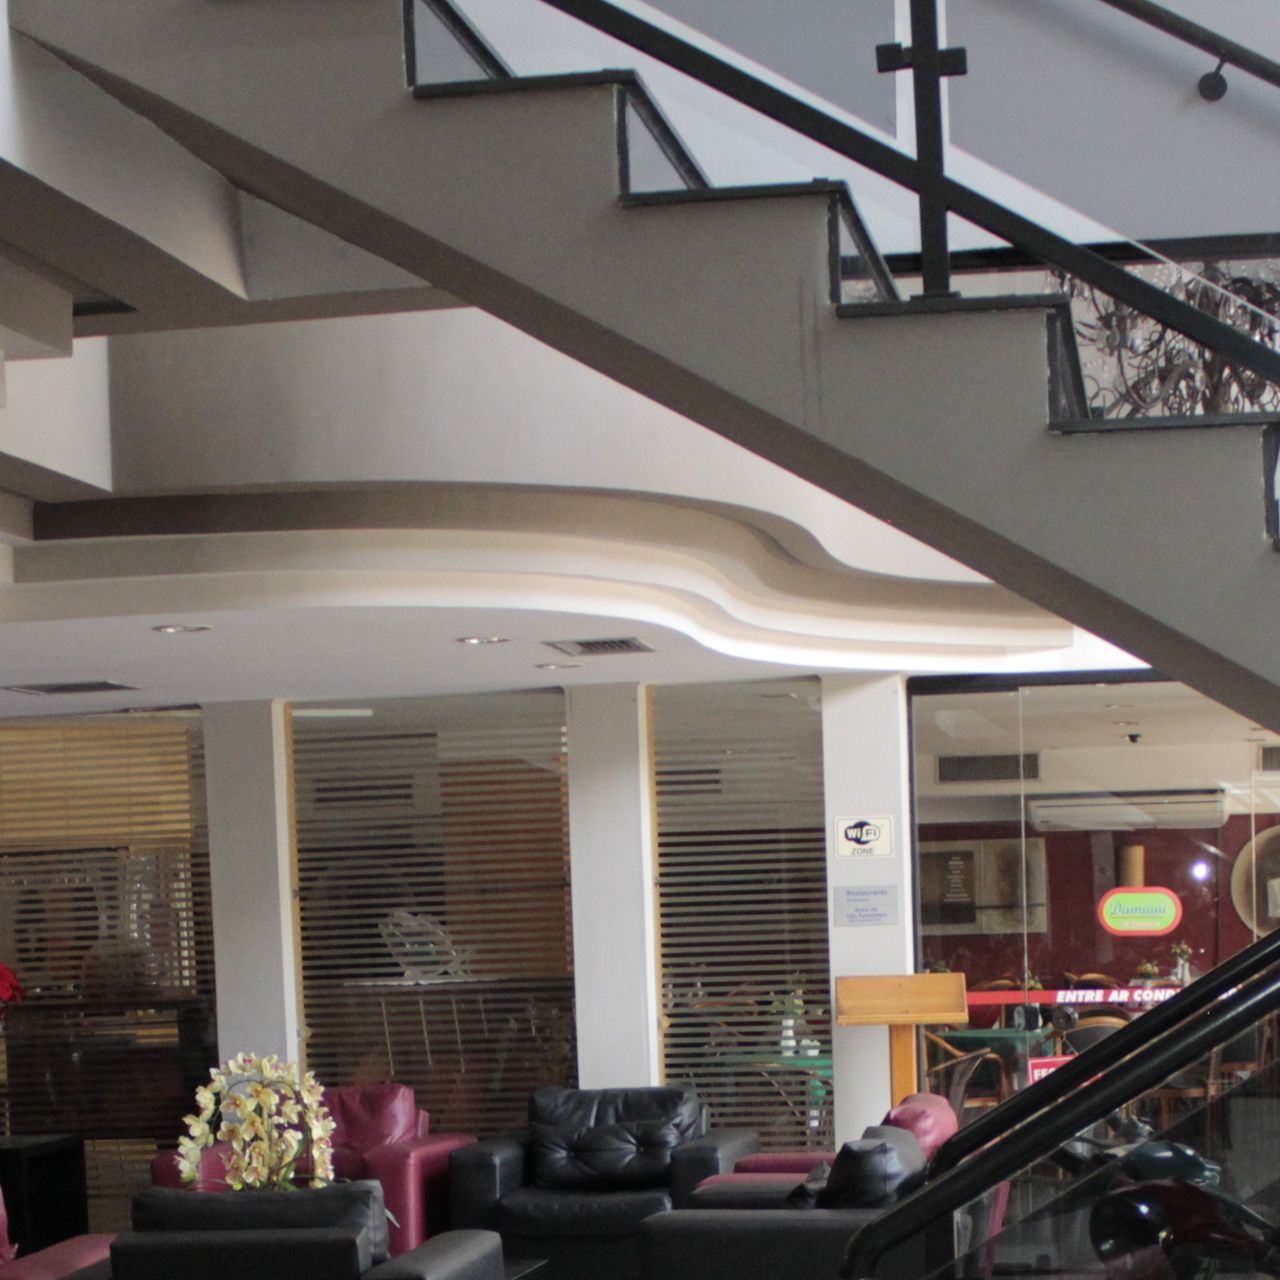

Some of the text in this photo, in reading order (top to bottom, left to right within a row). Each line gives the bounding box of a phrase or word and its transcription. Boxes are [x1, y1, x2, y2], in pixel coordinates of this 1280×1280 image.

[851, 848, 874, 856] ZONE
[1056, 990, 1105, 1003] ENTRE
[1108, 989, 1130, 1002] AR
